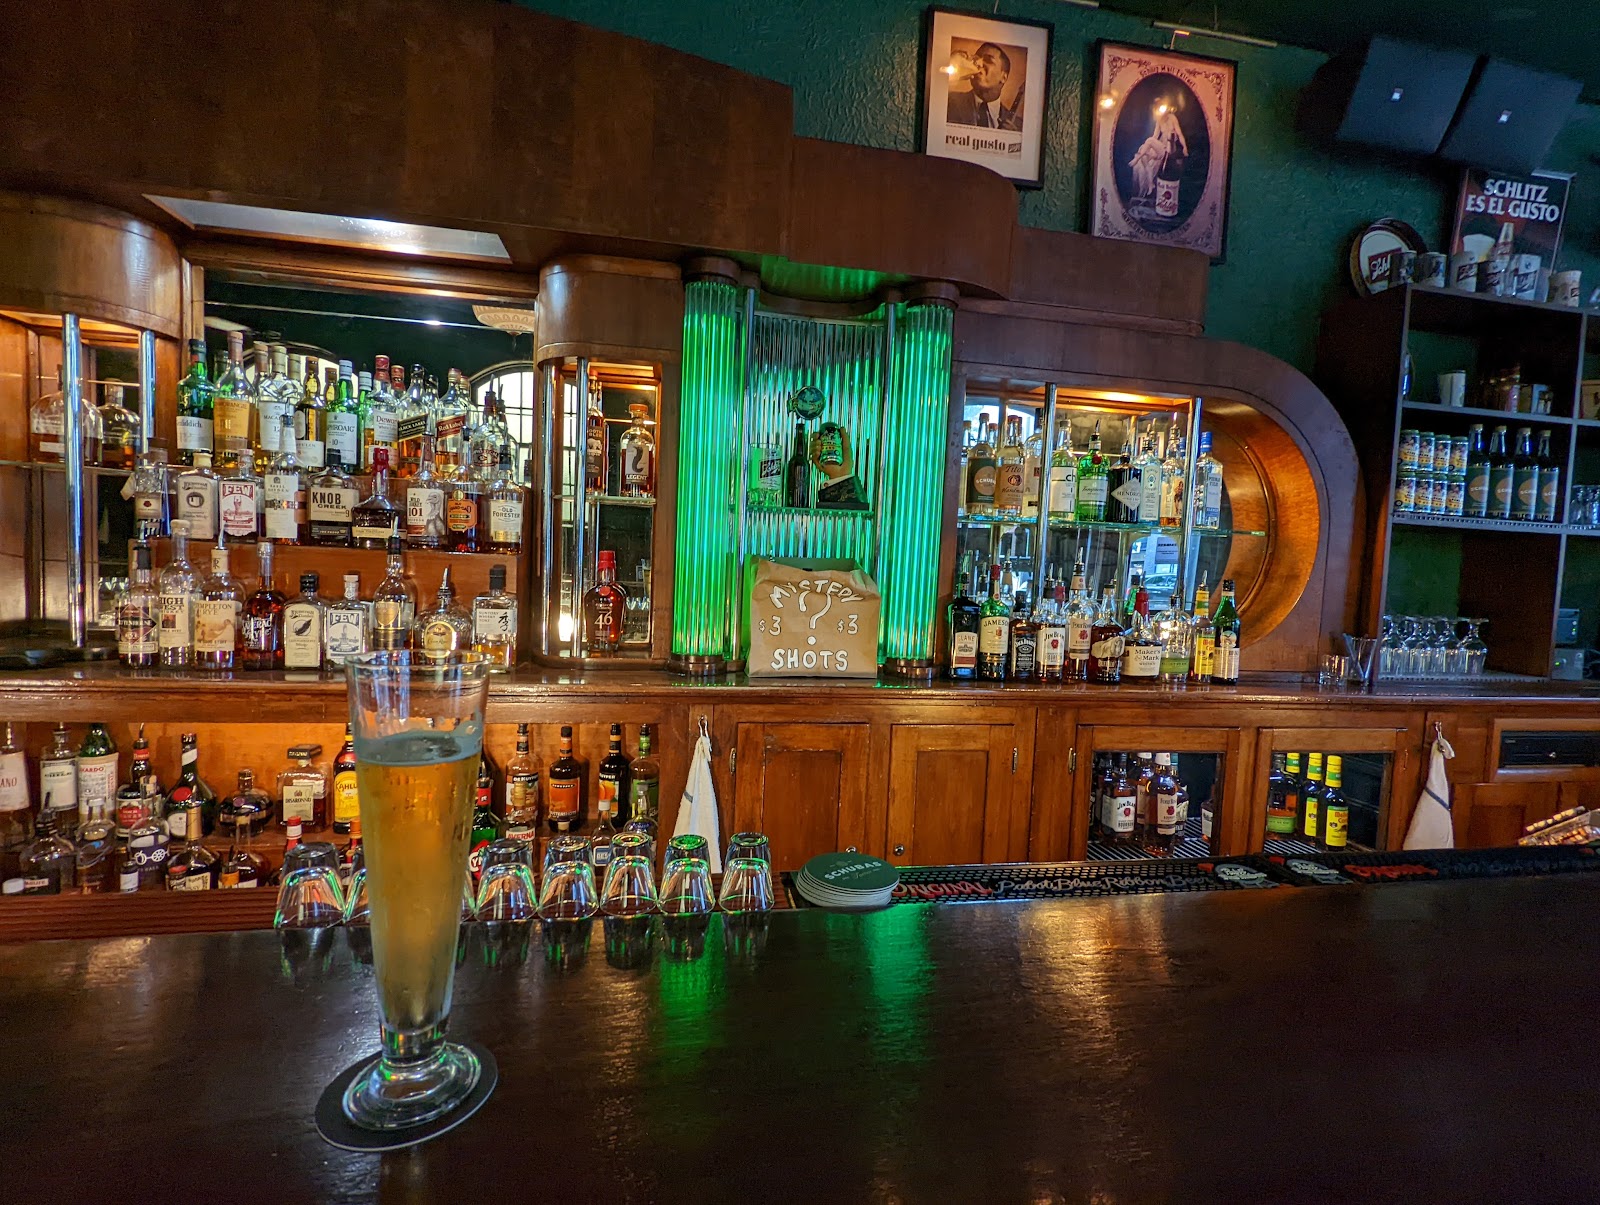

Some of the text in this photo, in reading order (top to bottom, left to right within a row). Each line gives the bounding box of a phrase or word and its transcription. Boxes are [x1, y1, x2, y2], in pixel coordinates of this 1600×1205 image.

[945, 134, 970, 147] real
[972, 138, 1006, 151] gusto
[1484, 179, 1549, 202] SCHLITZ
[1466, 194, 1560, 222] ES EL GUSTO
[1370, 258, 1391, 283] Schl
[327, 424, 355, 432] PHROAIG
[224, 484, 252, 496] FEW
[312, 492, 341, 504] KNOB
[409, 508, 422, 517] 101
[332, 613, 358, 624] FEW
[594, 611, 613, 629] 46
[770, 648, 849, 672] SHOTS
[1117, 802, 1126, 810] JIM
[824, 861, 882, 879] SCHUBAS
[892, 880, 993, 899] ORIGINAL
[1054, 878, 1101, 891] Blue
[1101, 876, 1166, 890] Ribbon
